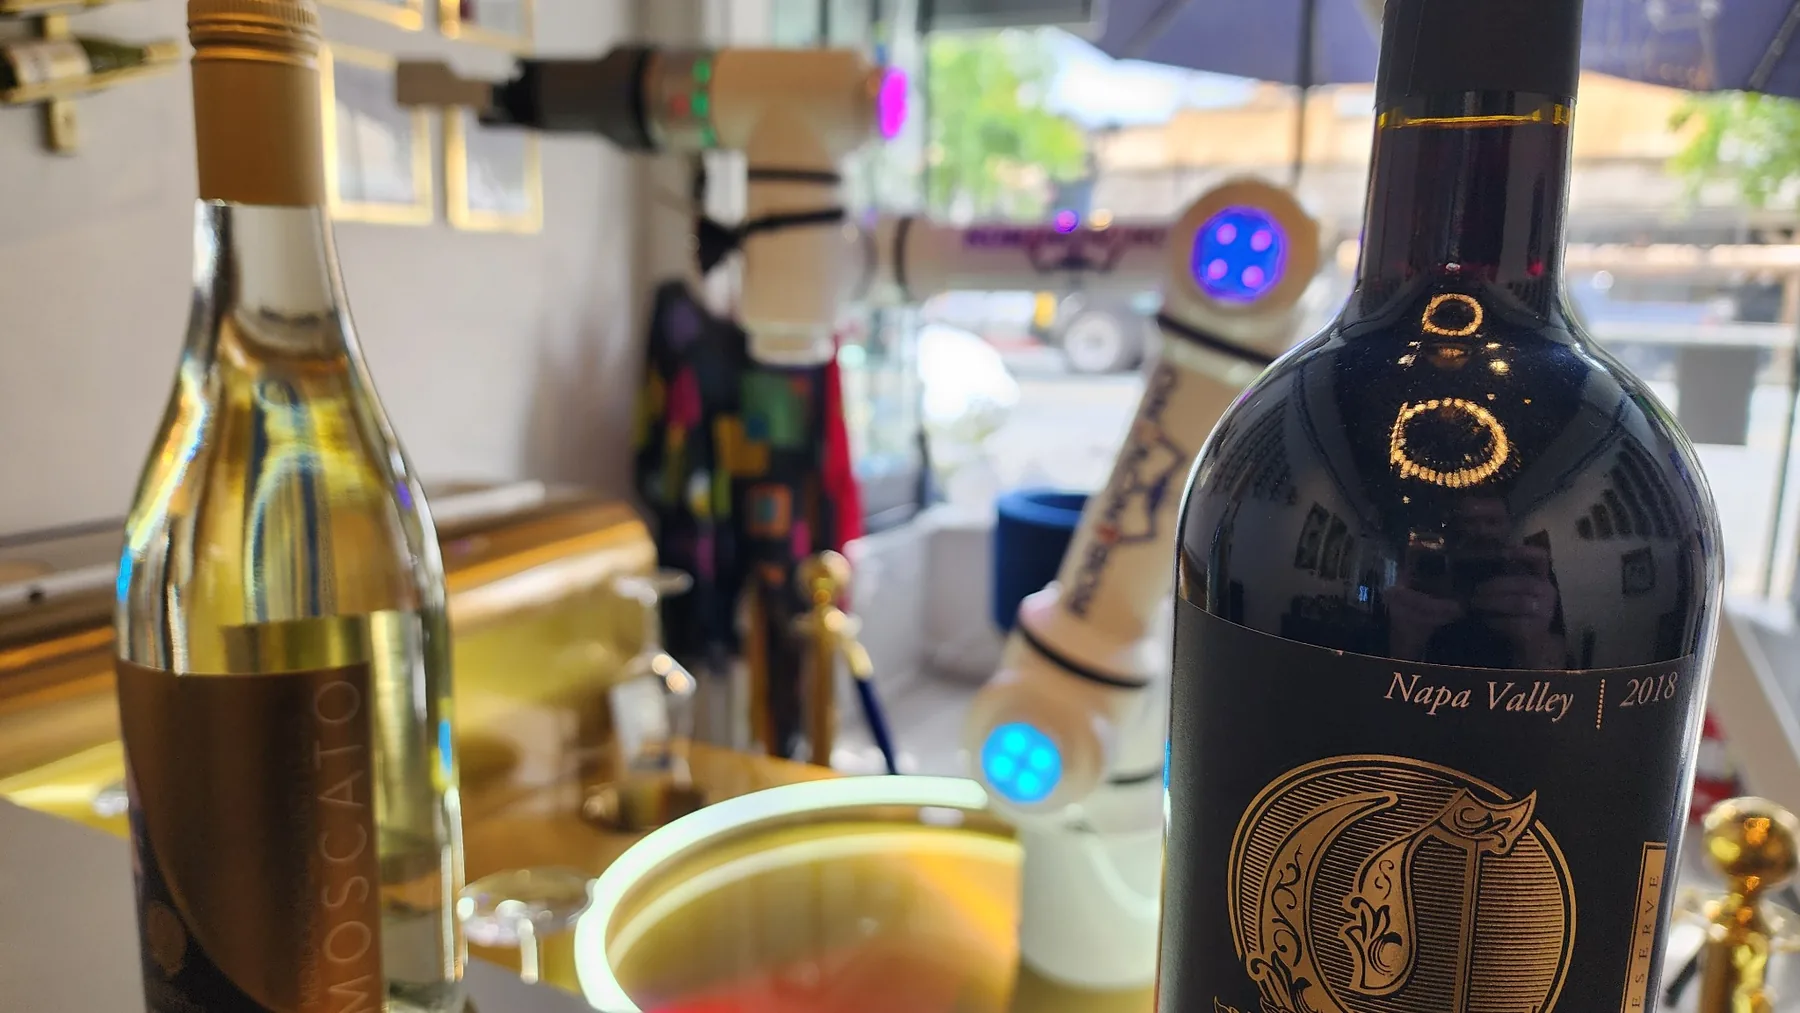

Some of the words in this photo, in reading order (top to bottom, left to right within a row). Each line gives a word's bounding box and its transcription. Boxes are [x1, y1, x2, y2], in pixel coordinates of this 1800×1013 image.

[1384, 671, 1471, 716] Napa
[1486, 681, 1574, 724] Valley
[1619, 671, 1679, 708] 2018
[315, 680, 375, 1013] MOSCATO
